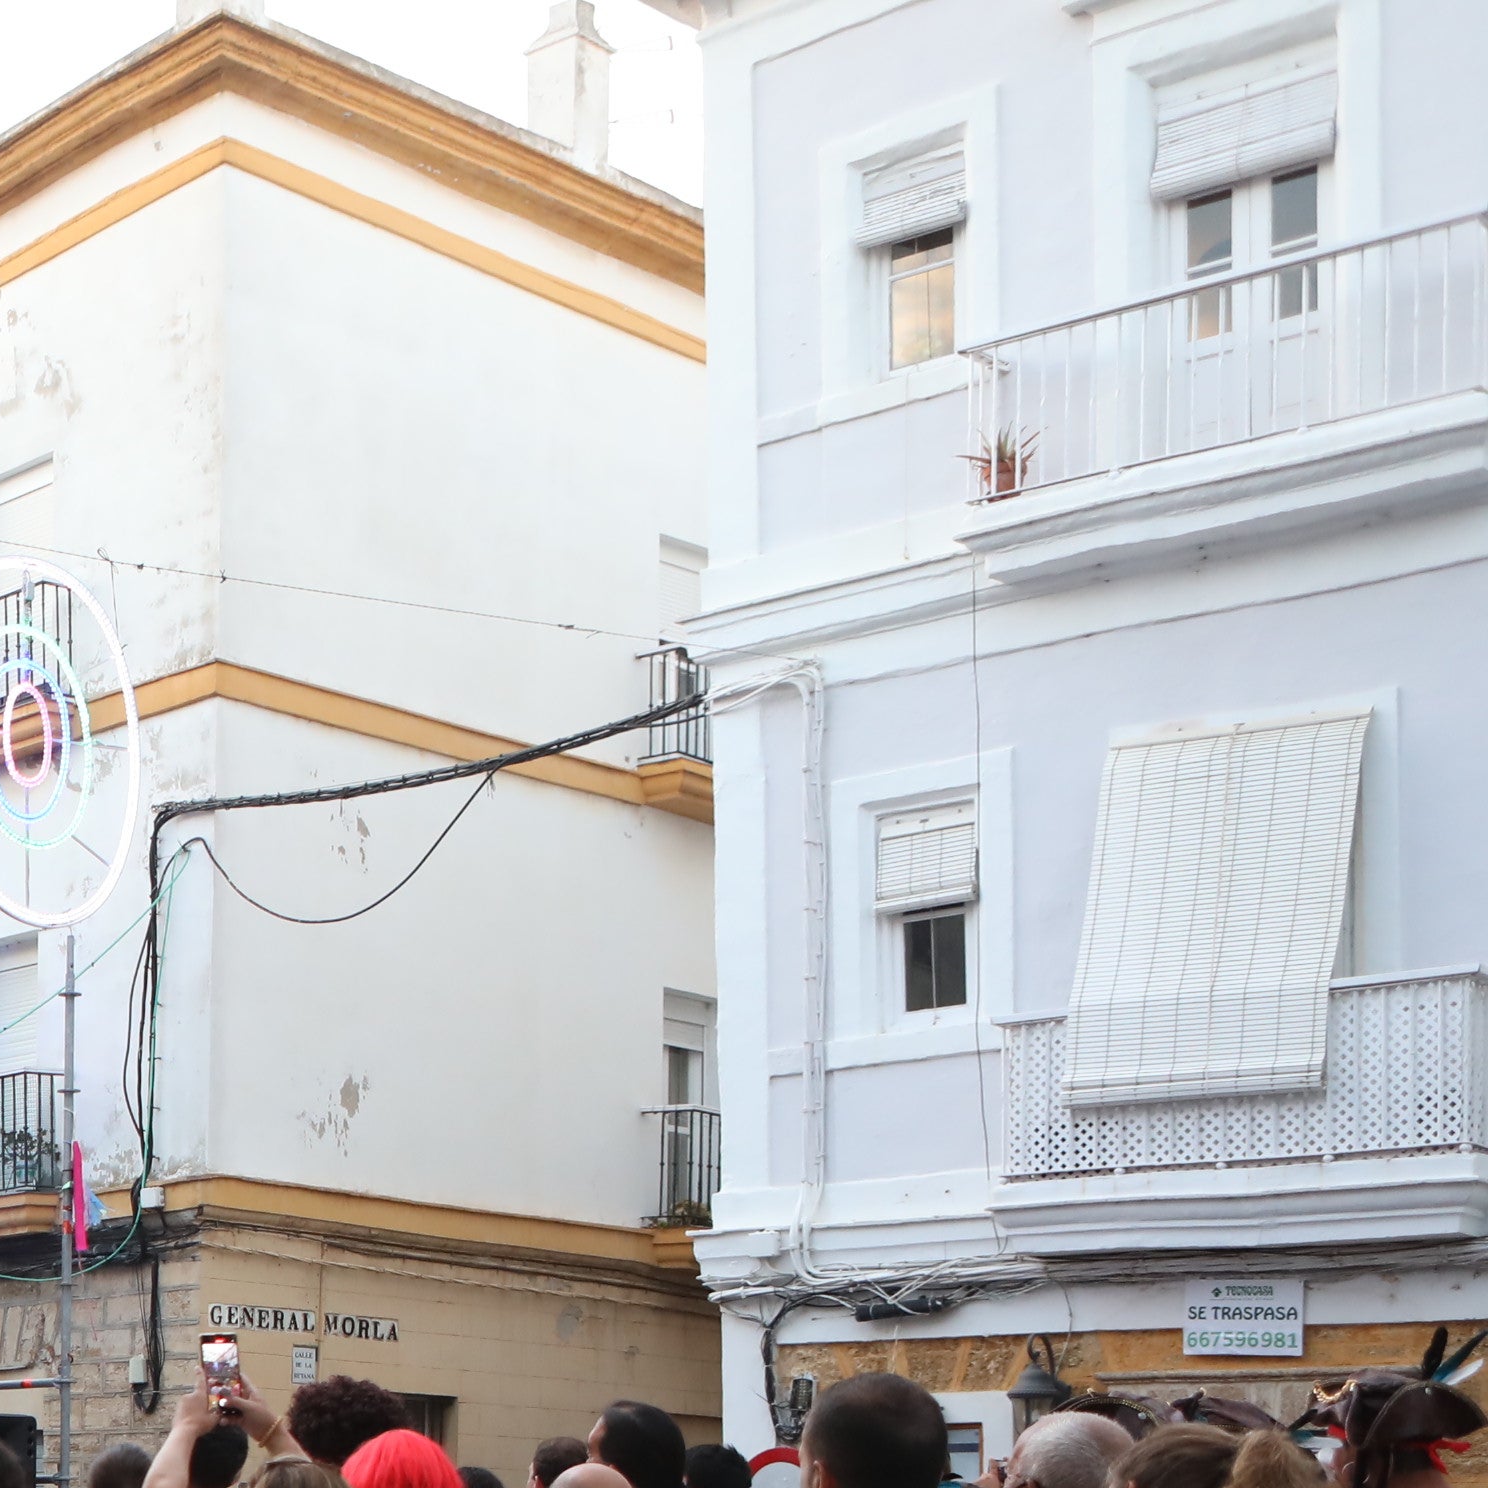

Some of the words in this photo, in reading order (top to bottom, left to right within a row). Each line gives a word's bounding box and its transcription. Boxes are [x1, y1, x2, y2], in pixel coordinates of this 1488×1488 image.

[1188, 1306, 1207, 1320] SE
[1211, 1306, 1299, 1321] TRASPASA
[209, 1305, 315, 1332] GENERAL
[325, 1314, 399, 1342] MORLA
[1187, 1331, 1299, 1349] 667596981
